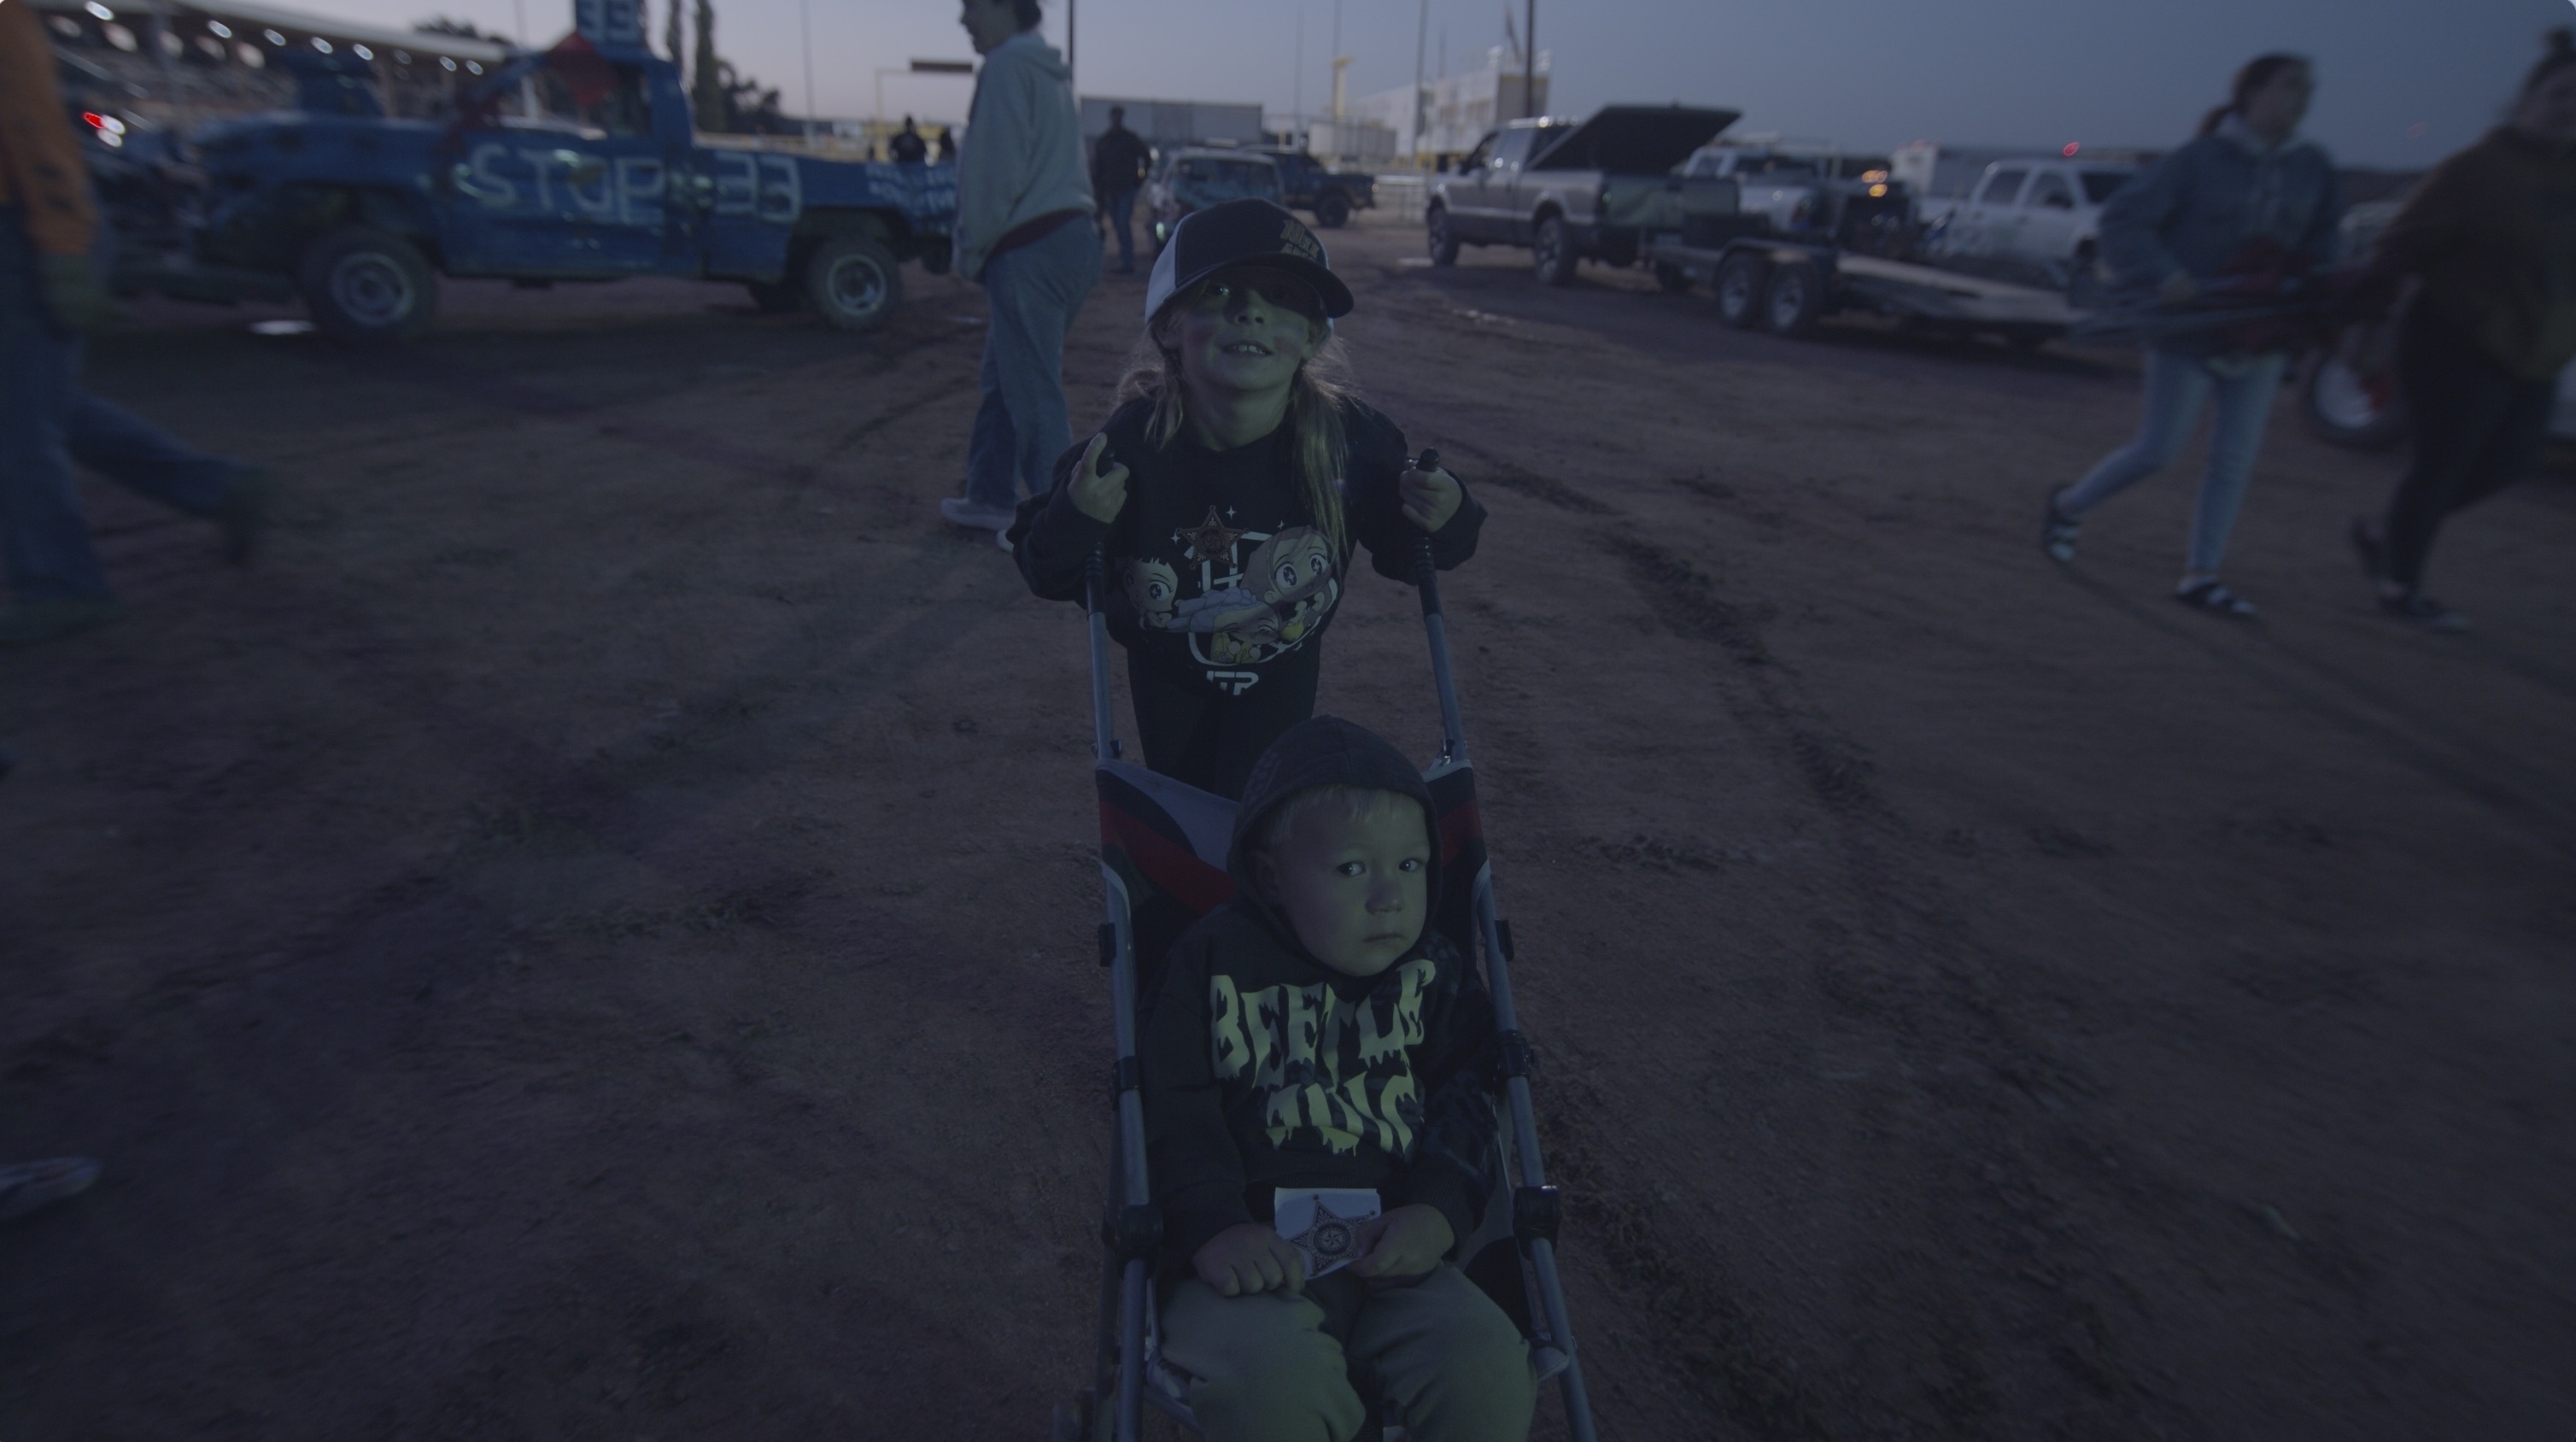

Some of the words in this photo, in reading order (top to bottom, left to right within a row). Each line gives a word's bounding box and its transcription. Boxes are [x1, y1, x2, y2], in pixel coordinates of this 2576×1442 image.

[453, 143, 667, 226] STOP
[714, 150, 803, 224] 33
[1209, 958, 1436, 1091] BEETLE
